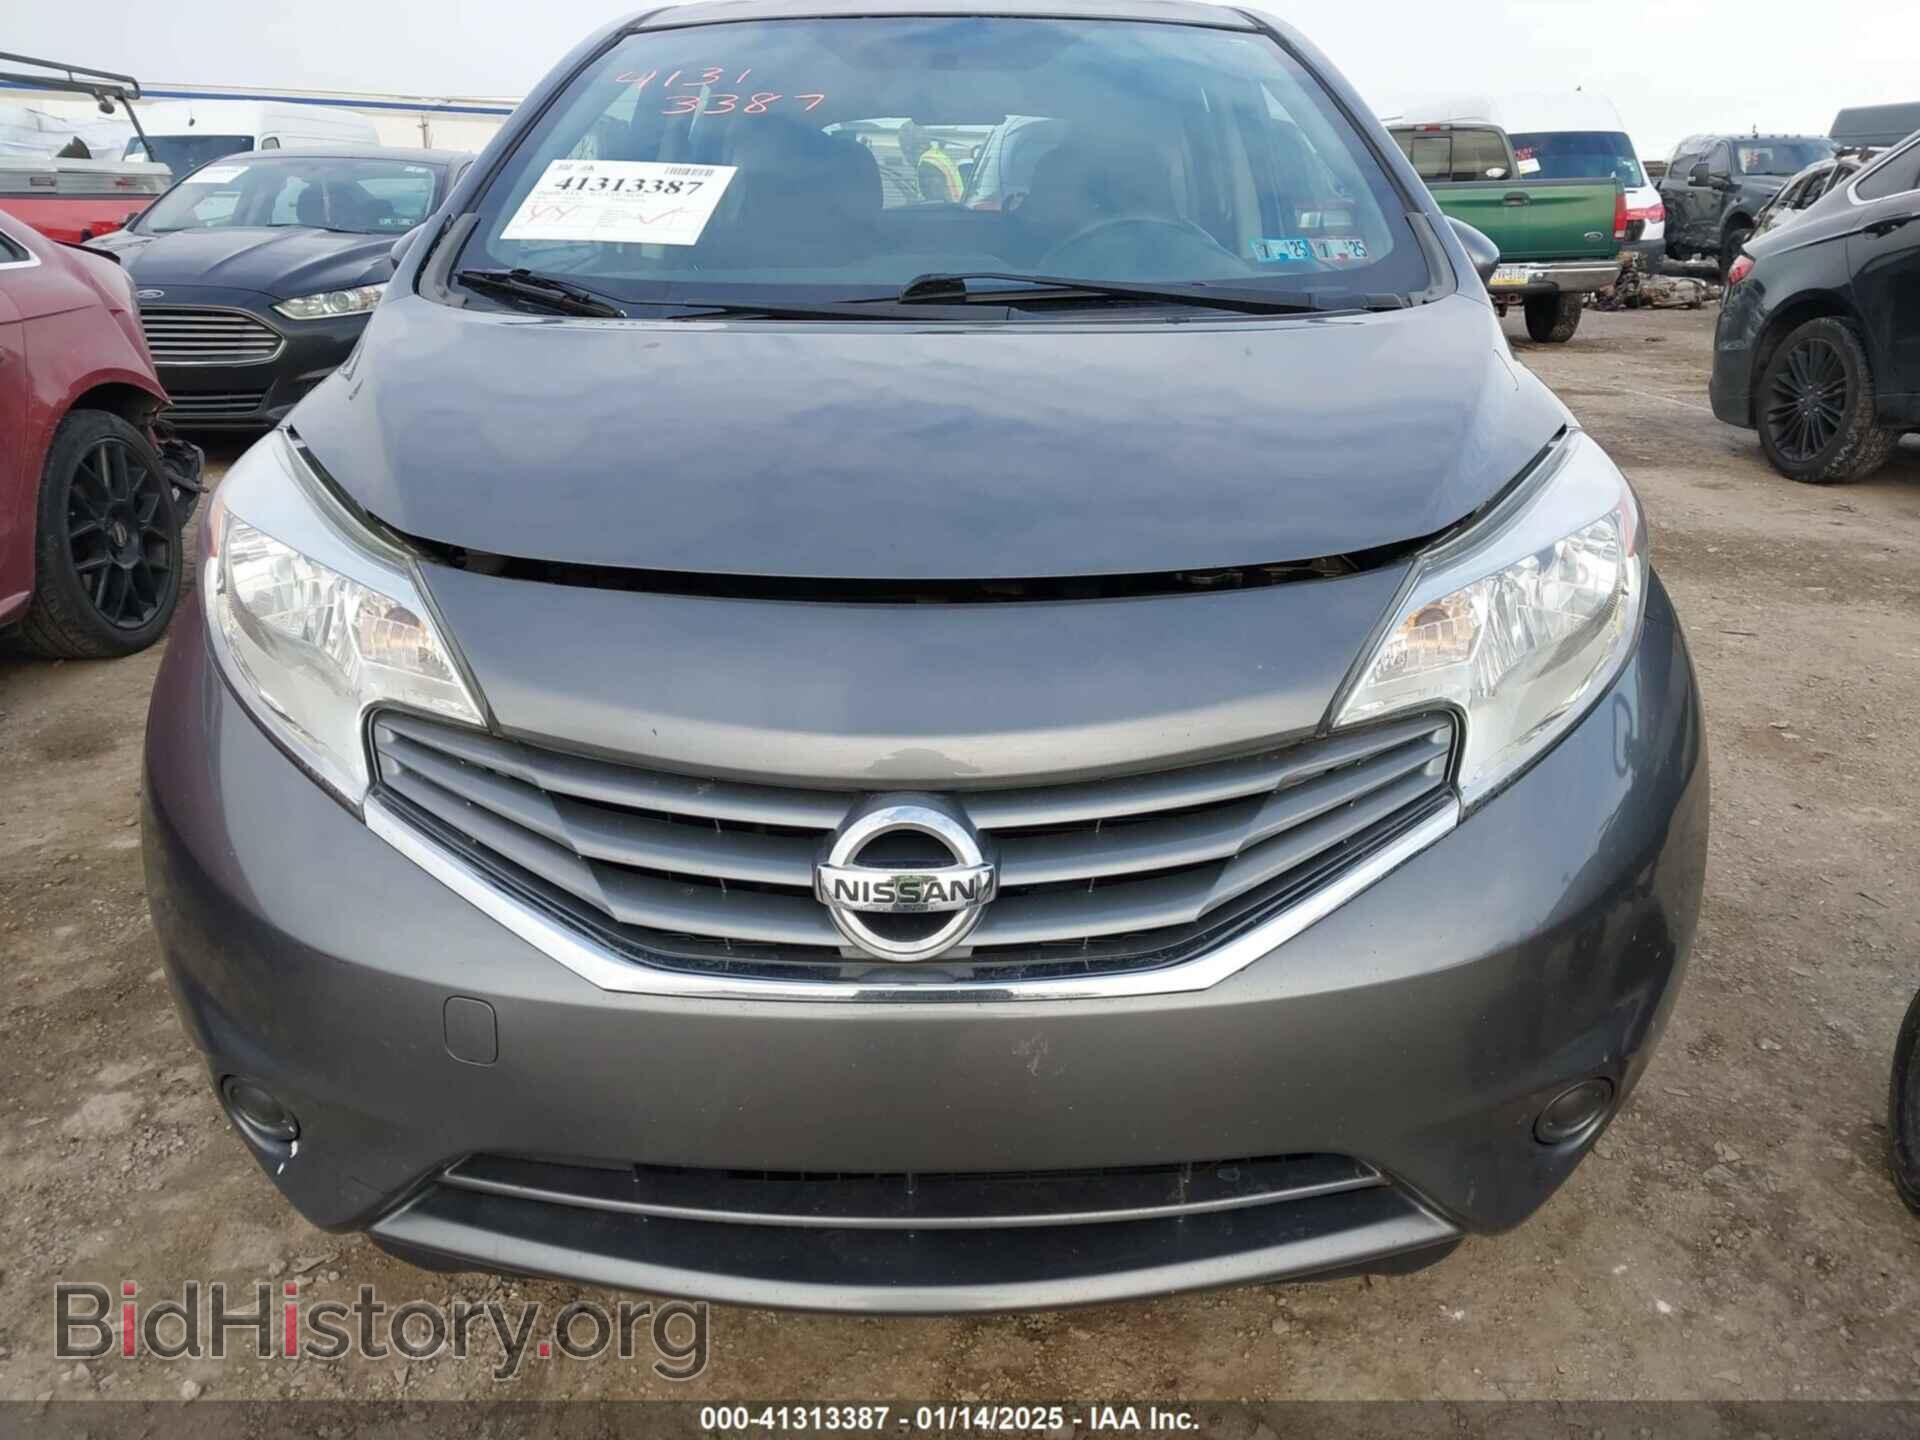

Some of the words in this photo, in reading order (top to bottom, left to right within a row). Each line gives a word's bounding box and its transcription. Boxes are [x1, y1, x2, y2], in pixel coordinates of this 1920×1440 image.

[615, 66, 752, 89] 4131
[661, 92, 825, 115] 3387
[554, 175, 705, 197] 41313387
[834, 878, 976, 904] NISSAN
